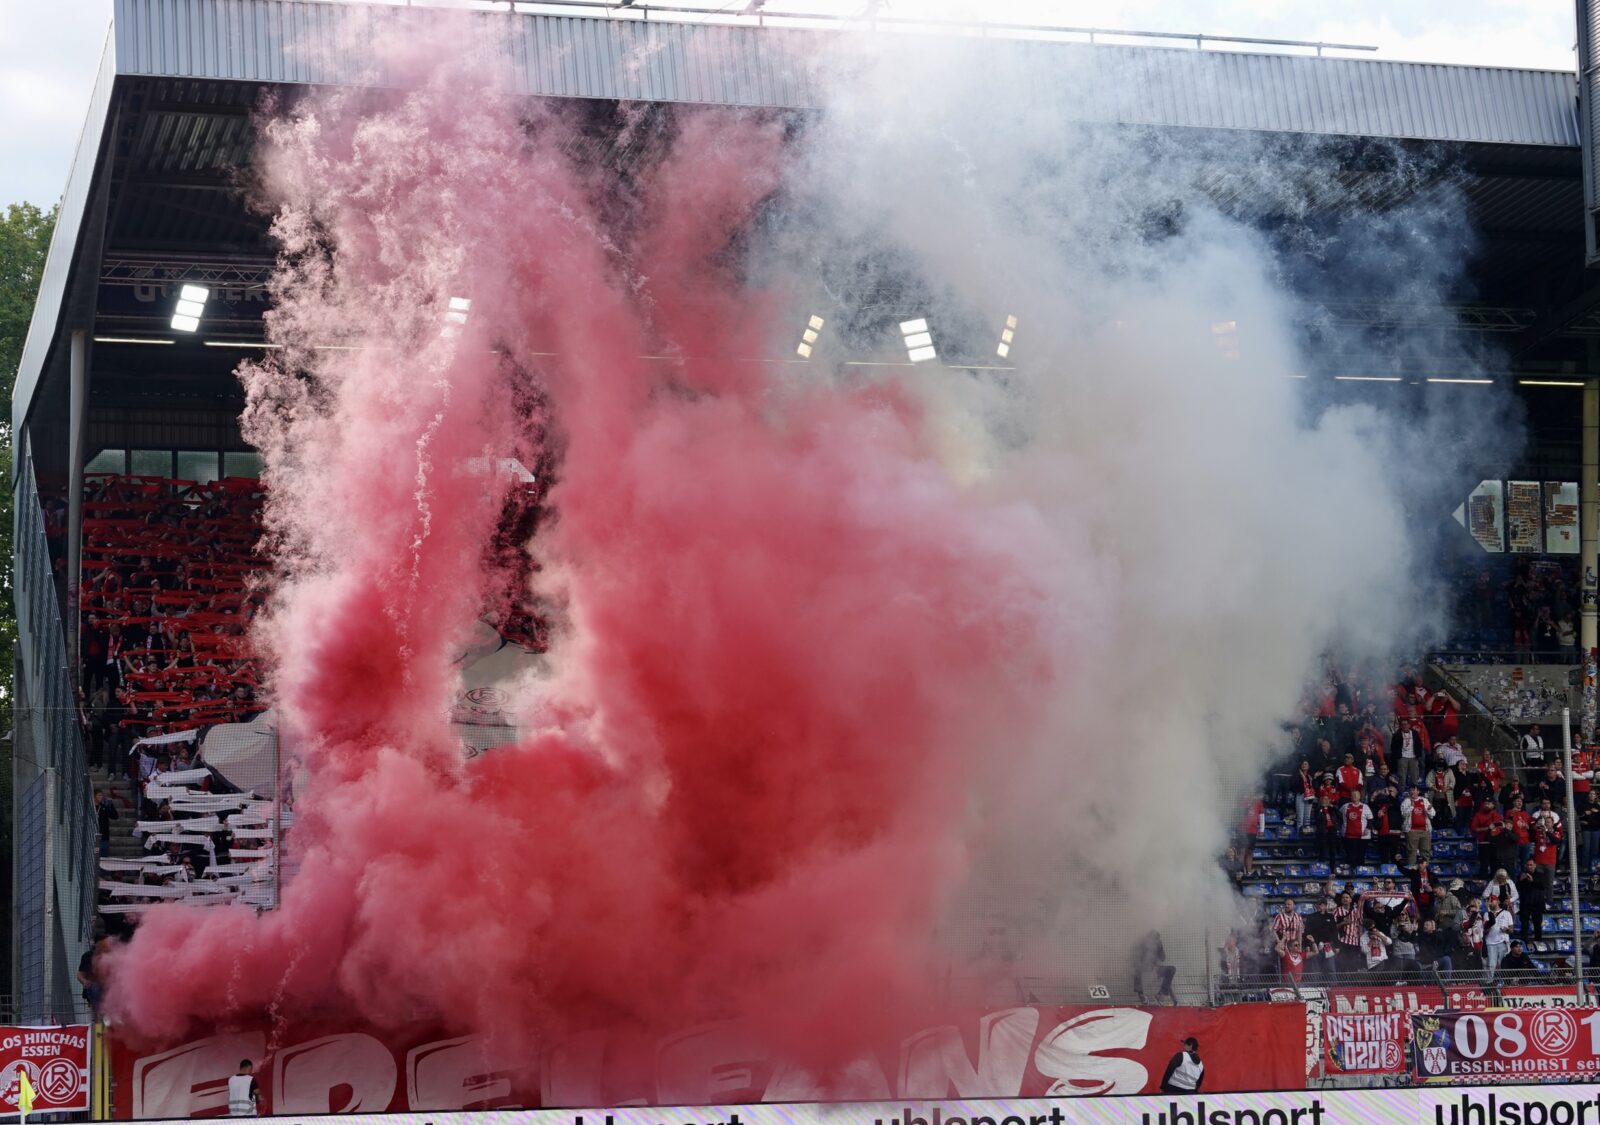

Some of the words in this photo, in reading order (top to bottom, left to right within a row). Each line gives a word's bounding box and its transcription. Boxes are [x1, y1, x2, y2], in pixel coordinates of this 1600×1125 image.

[1090, 986, 1107, 997] 26
[1326, 1013, 1401, 1042] DISTRIKT
[1454, 1012, 1527, 1059] 08
[24, 1032, 86, 1049] HINCHAS
[21, 1045, 61, 1057] ESSEN
[1451, 1057, 1570, 1075] ESSEN-HORST
